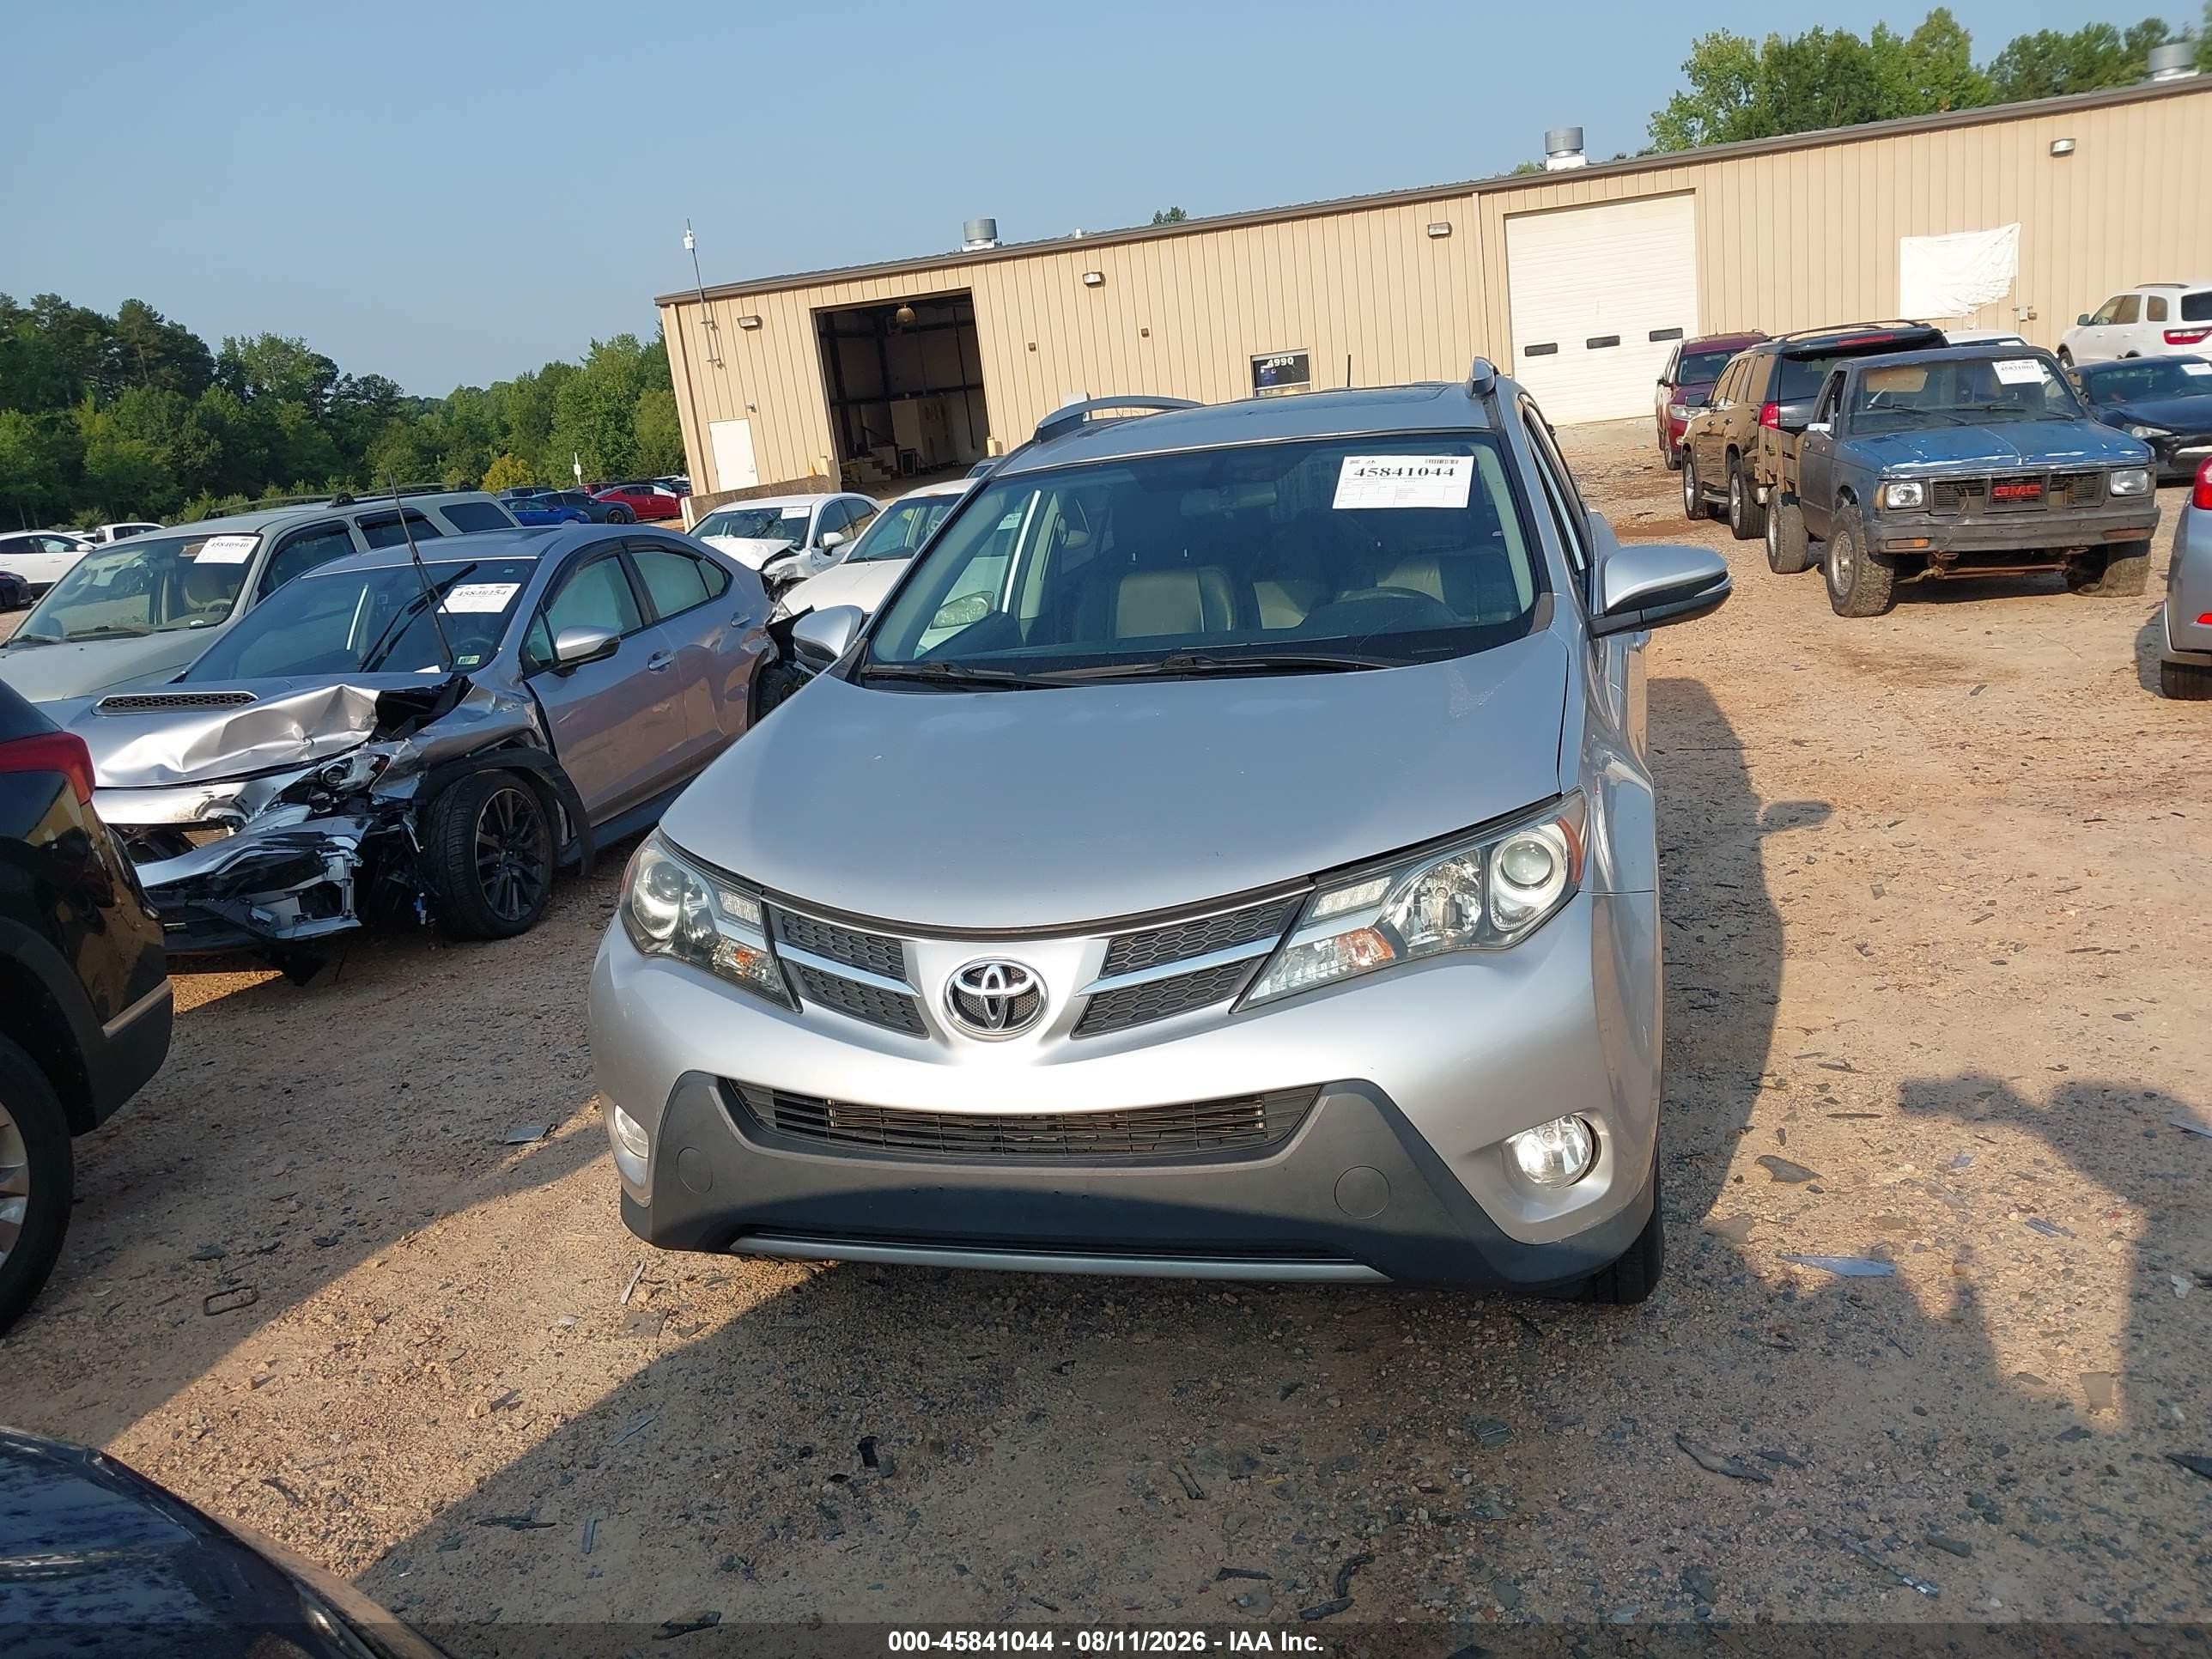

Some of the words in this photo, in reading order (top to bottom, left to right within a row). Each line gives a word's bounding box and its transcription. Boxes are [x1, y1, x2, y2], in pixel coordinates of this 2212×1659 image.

[1267, 356, 1294, 368] 4990
[1353, 467, 1455, 477] 45841044
[1995, 484, 2041, 496] GMC
